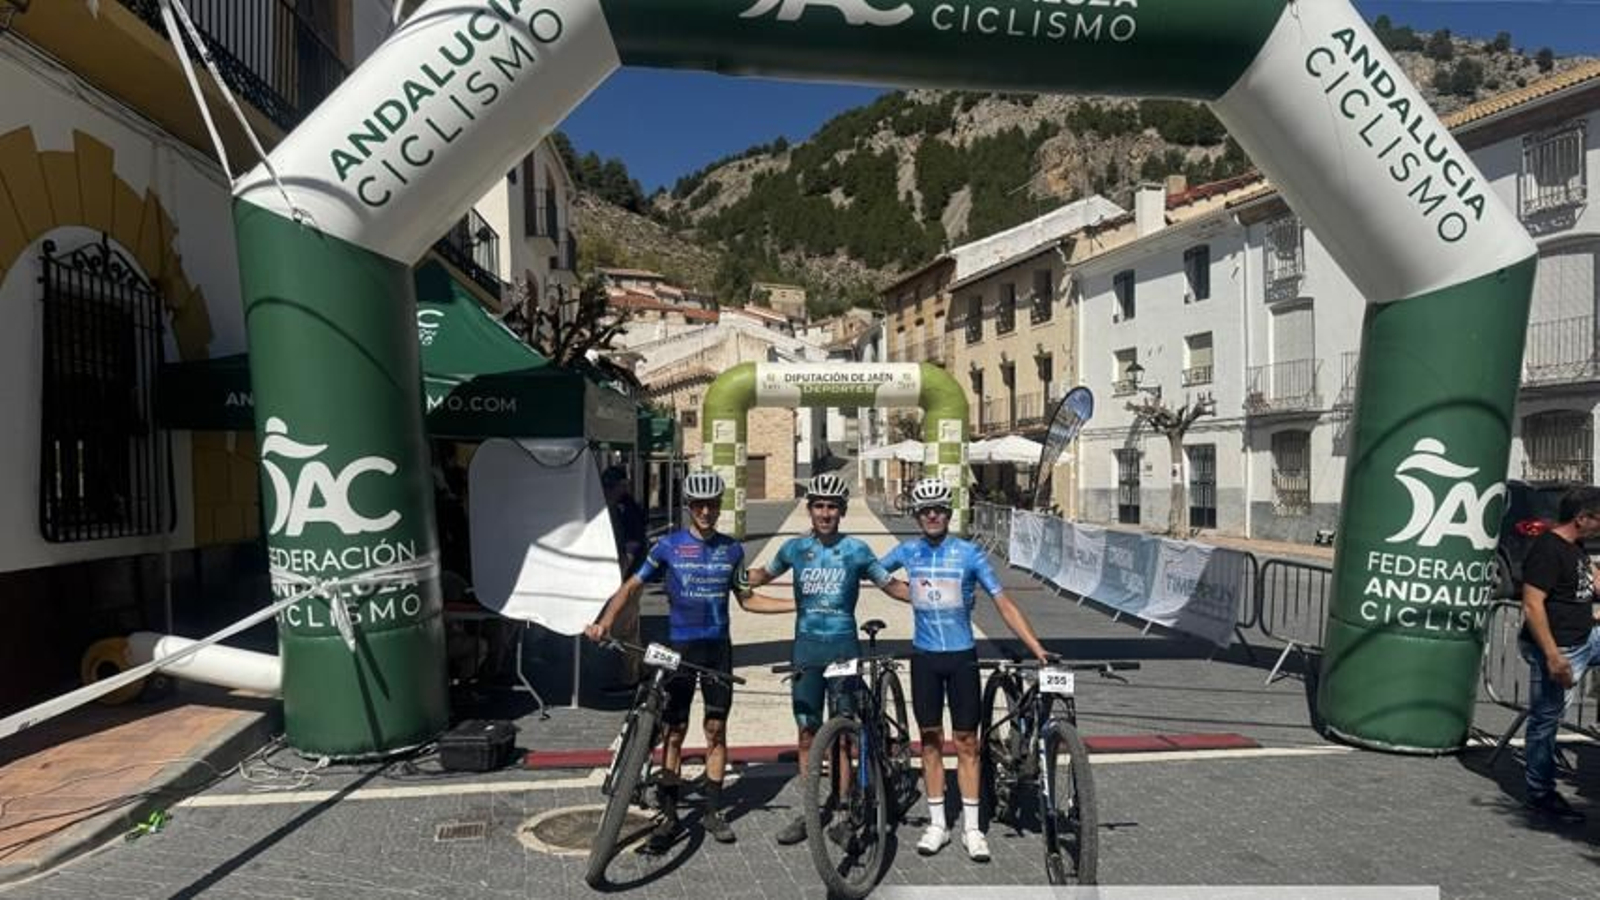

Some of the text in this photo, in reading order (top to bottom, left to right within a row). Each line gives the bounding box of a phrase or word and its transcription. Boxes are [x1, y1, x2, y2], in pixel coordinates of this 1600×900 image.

[931, 5, 1137, 41] CICLISMO
[357, 8, 563, 208] CICLISMO
[1332, 27, 1486, 221] ANDALUCÍA
[1305, 47, 1468, 243] CICLISMO
[784, 371, 849, 382] DIPUTACIÓN
[851, 373, 865, 382] DE
[1364, 577, 1494, 606] ANDALUZ
[1361, 601, 1487, 631] CICLISM
